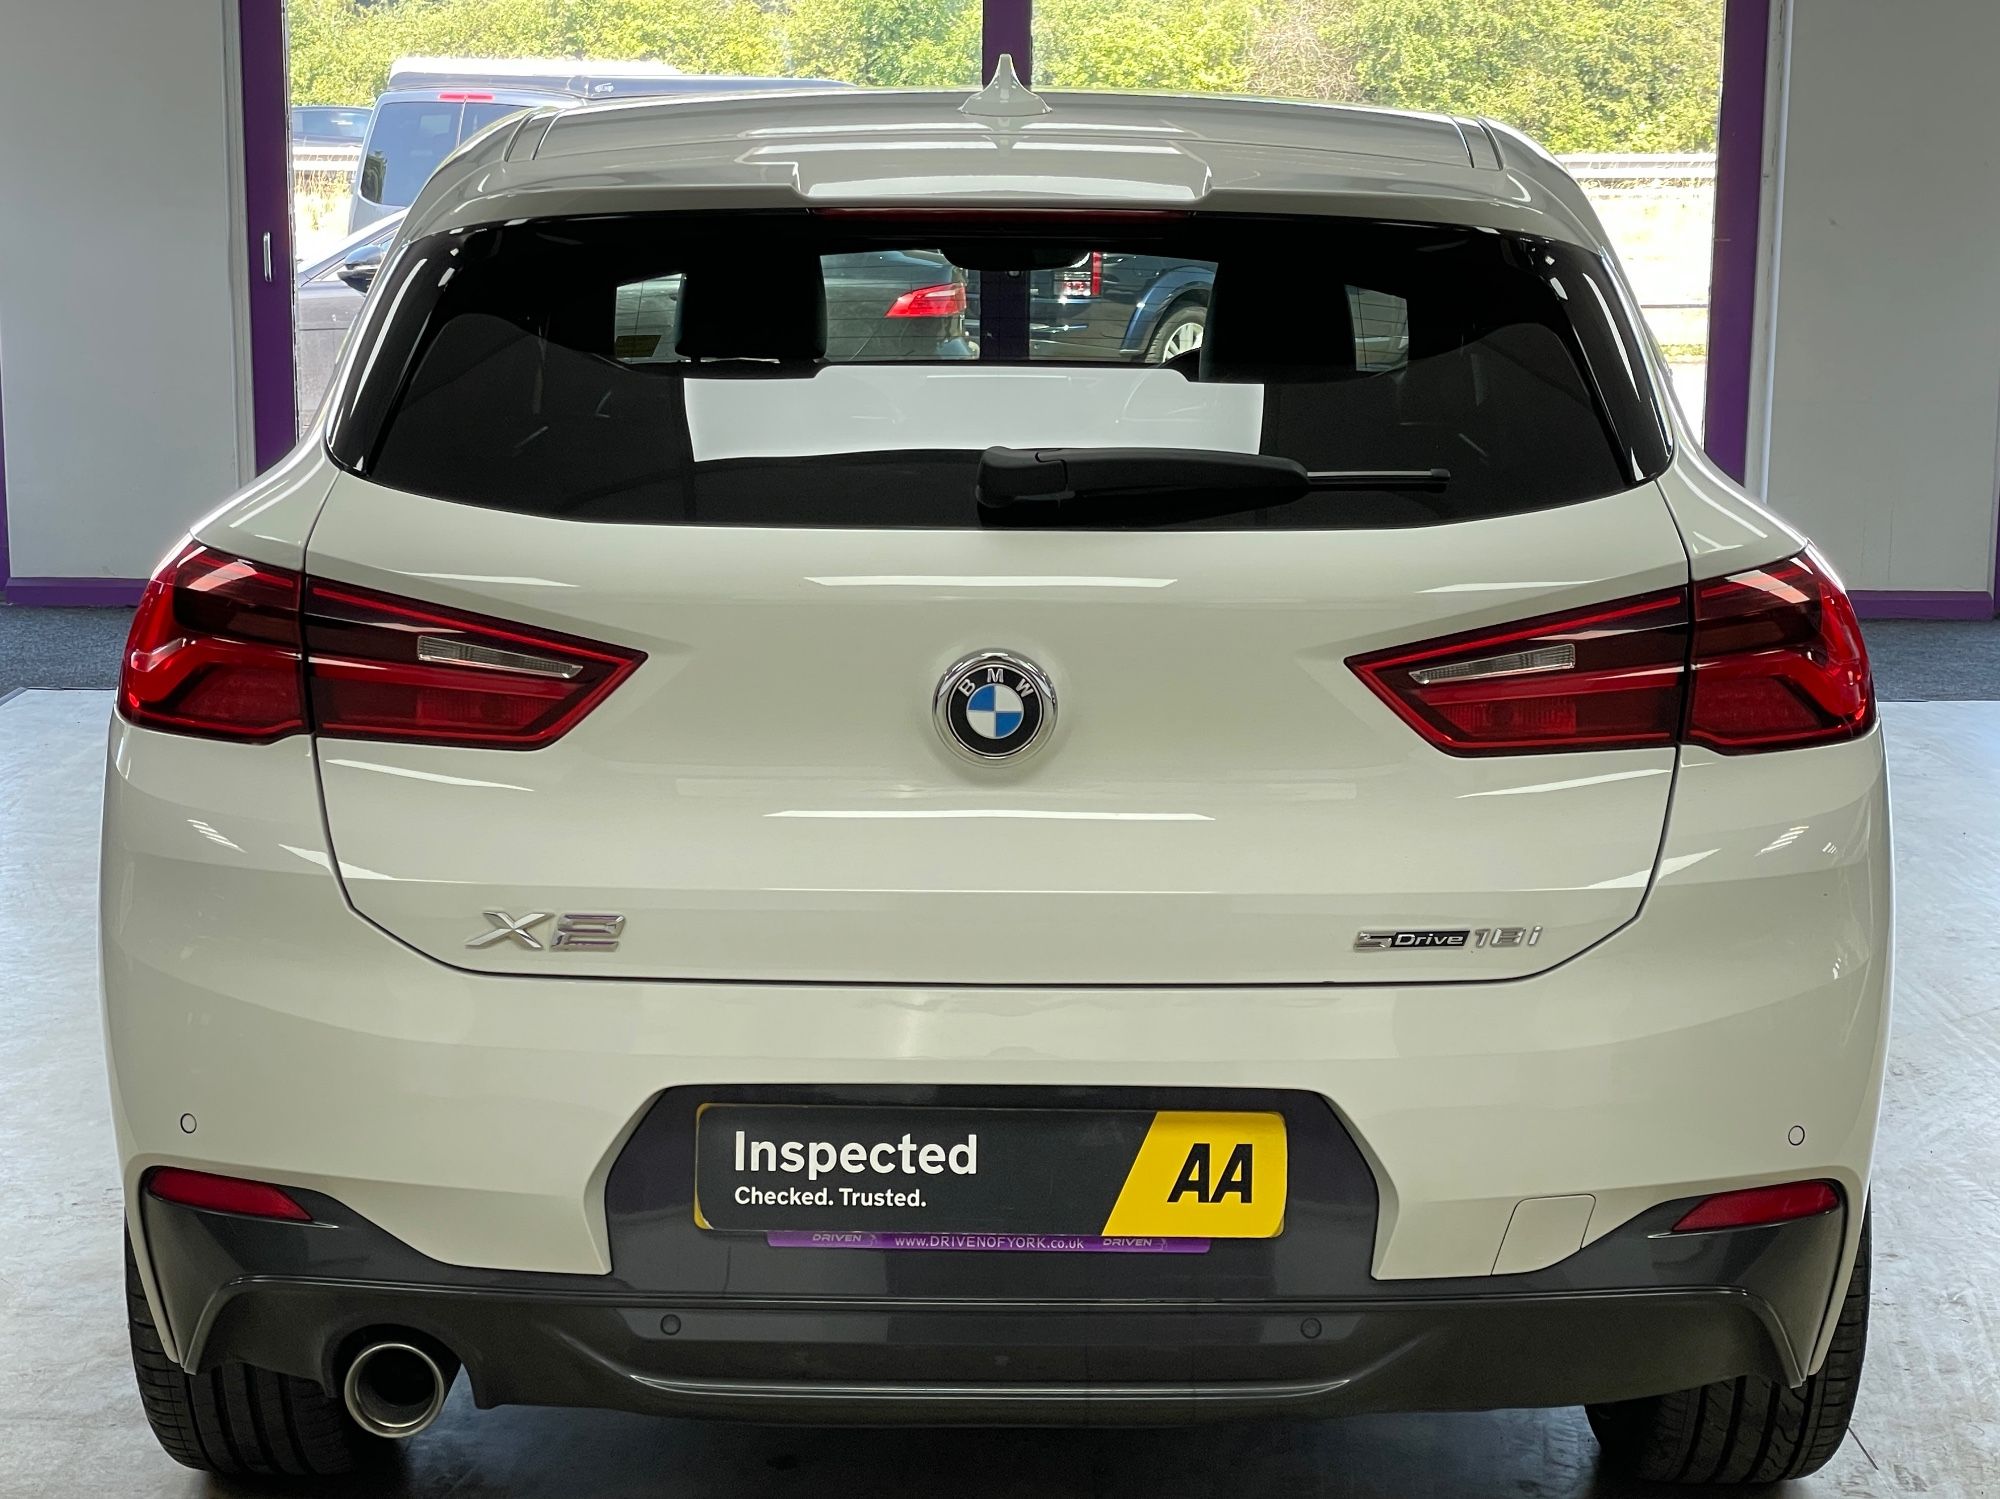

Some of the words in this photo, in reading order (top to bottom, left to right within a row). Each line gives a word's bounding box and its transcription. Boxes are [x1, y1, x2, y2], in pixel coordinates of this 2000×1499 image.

[958, 668, 1034, 697] BMW
[464, 911, 626, 951] X2
[735, 1130, 977, 1181] Inspected
[1166, 1143, 1253, 1204] AA
[734, 1186, 834, 1206] Checked.
[839, 1187, 927, 1207] Trusted.
[812, 1233, 862, 1243] DRIVEN
[894, 1235, 1085, 1249] www.DRIVENOFYORK.co.uk
[1103, 1238, 1152, 1248] DRIVEN
